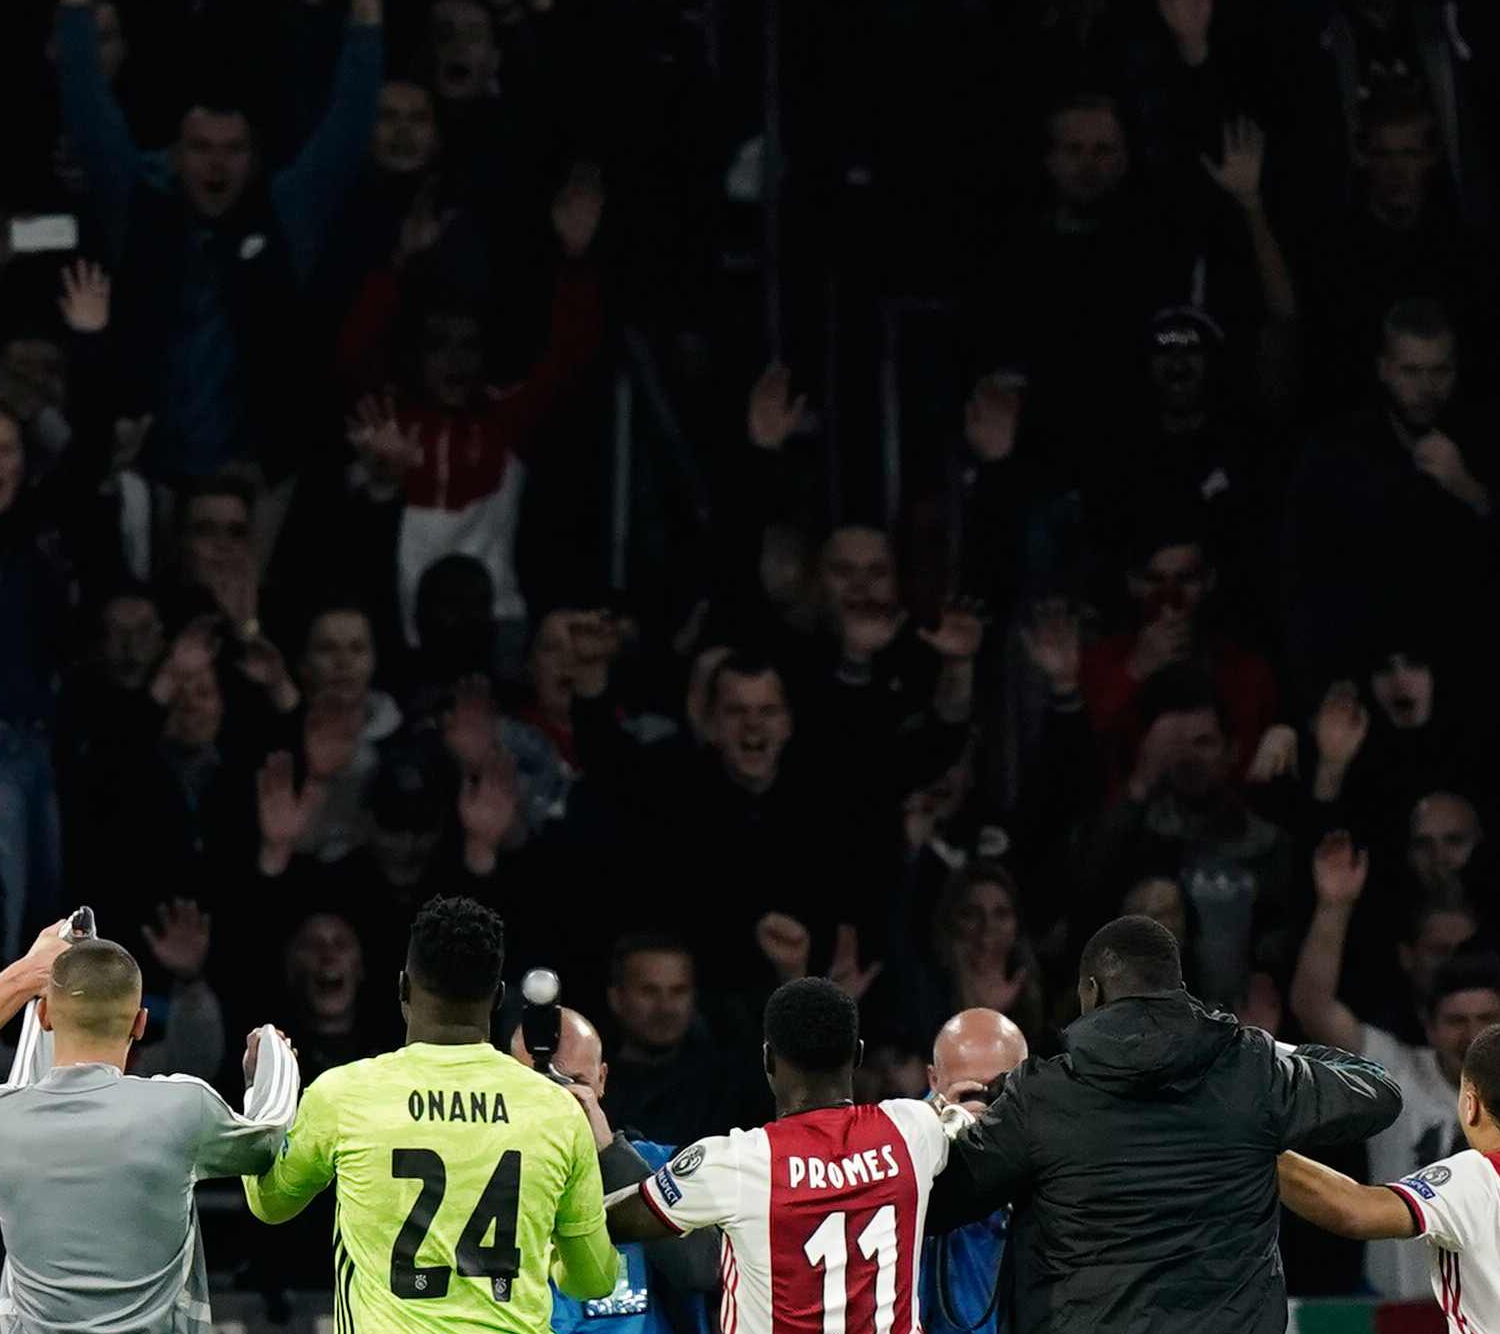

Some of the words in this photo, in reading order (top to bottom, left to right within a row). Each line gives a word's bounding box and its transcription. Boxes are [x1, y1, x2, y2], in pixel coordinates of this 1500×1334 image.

[407, 1089, 510, 1124] ONANA
[788, 1144, 900, 1190] PROMES
[390, 1147, 522, 1303] 24
